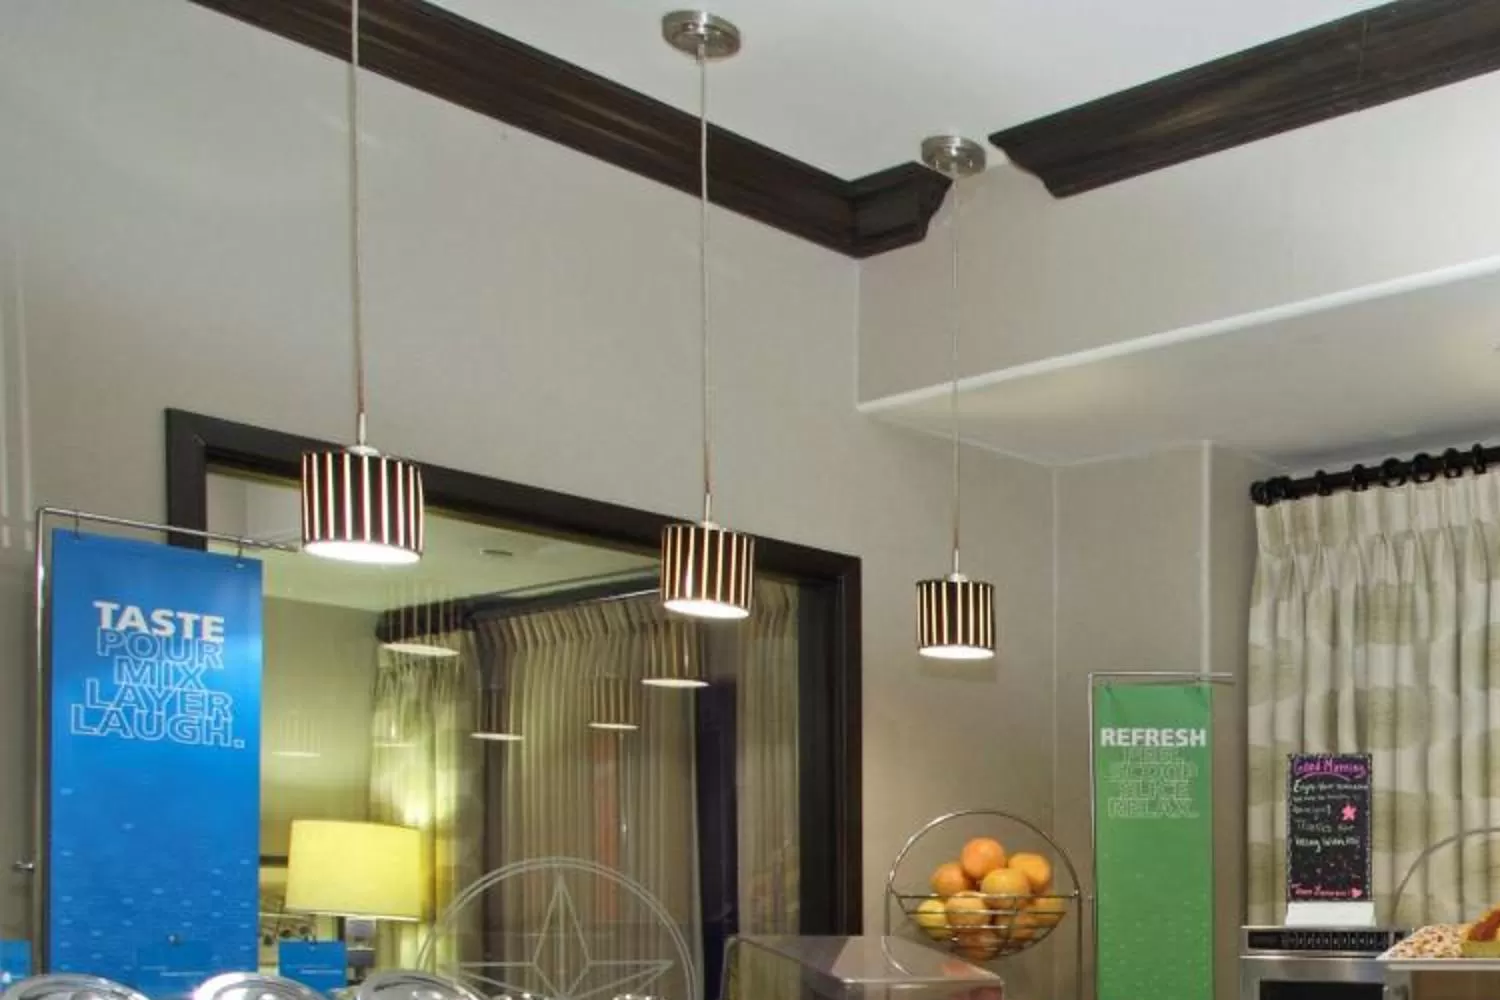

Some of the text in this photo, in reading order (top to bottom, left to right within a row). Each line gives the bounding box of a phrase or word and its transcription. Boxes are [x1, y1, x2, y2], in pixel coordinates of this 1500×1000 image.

[92, 600, 225, 643] TASTE
[96, 627, 224, 670] POUR
[113, 655, 208, 691] MIX
[85, 677, 234, 724] LAYER
[70, 703, 246, 749] LAUGH.
[1100, 727, 1207, 748] REFRESH
